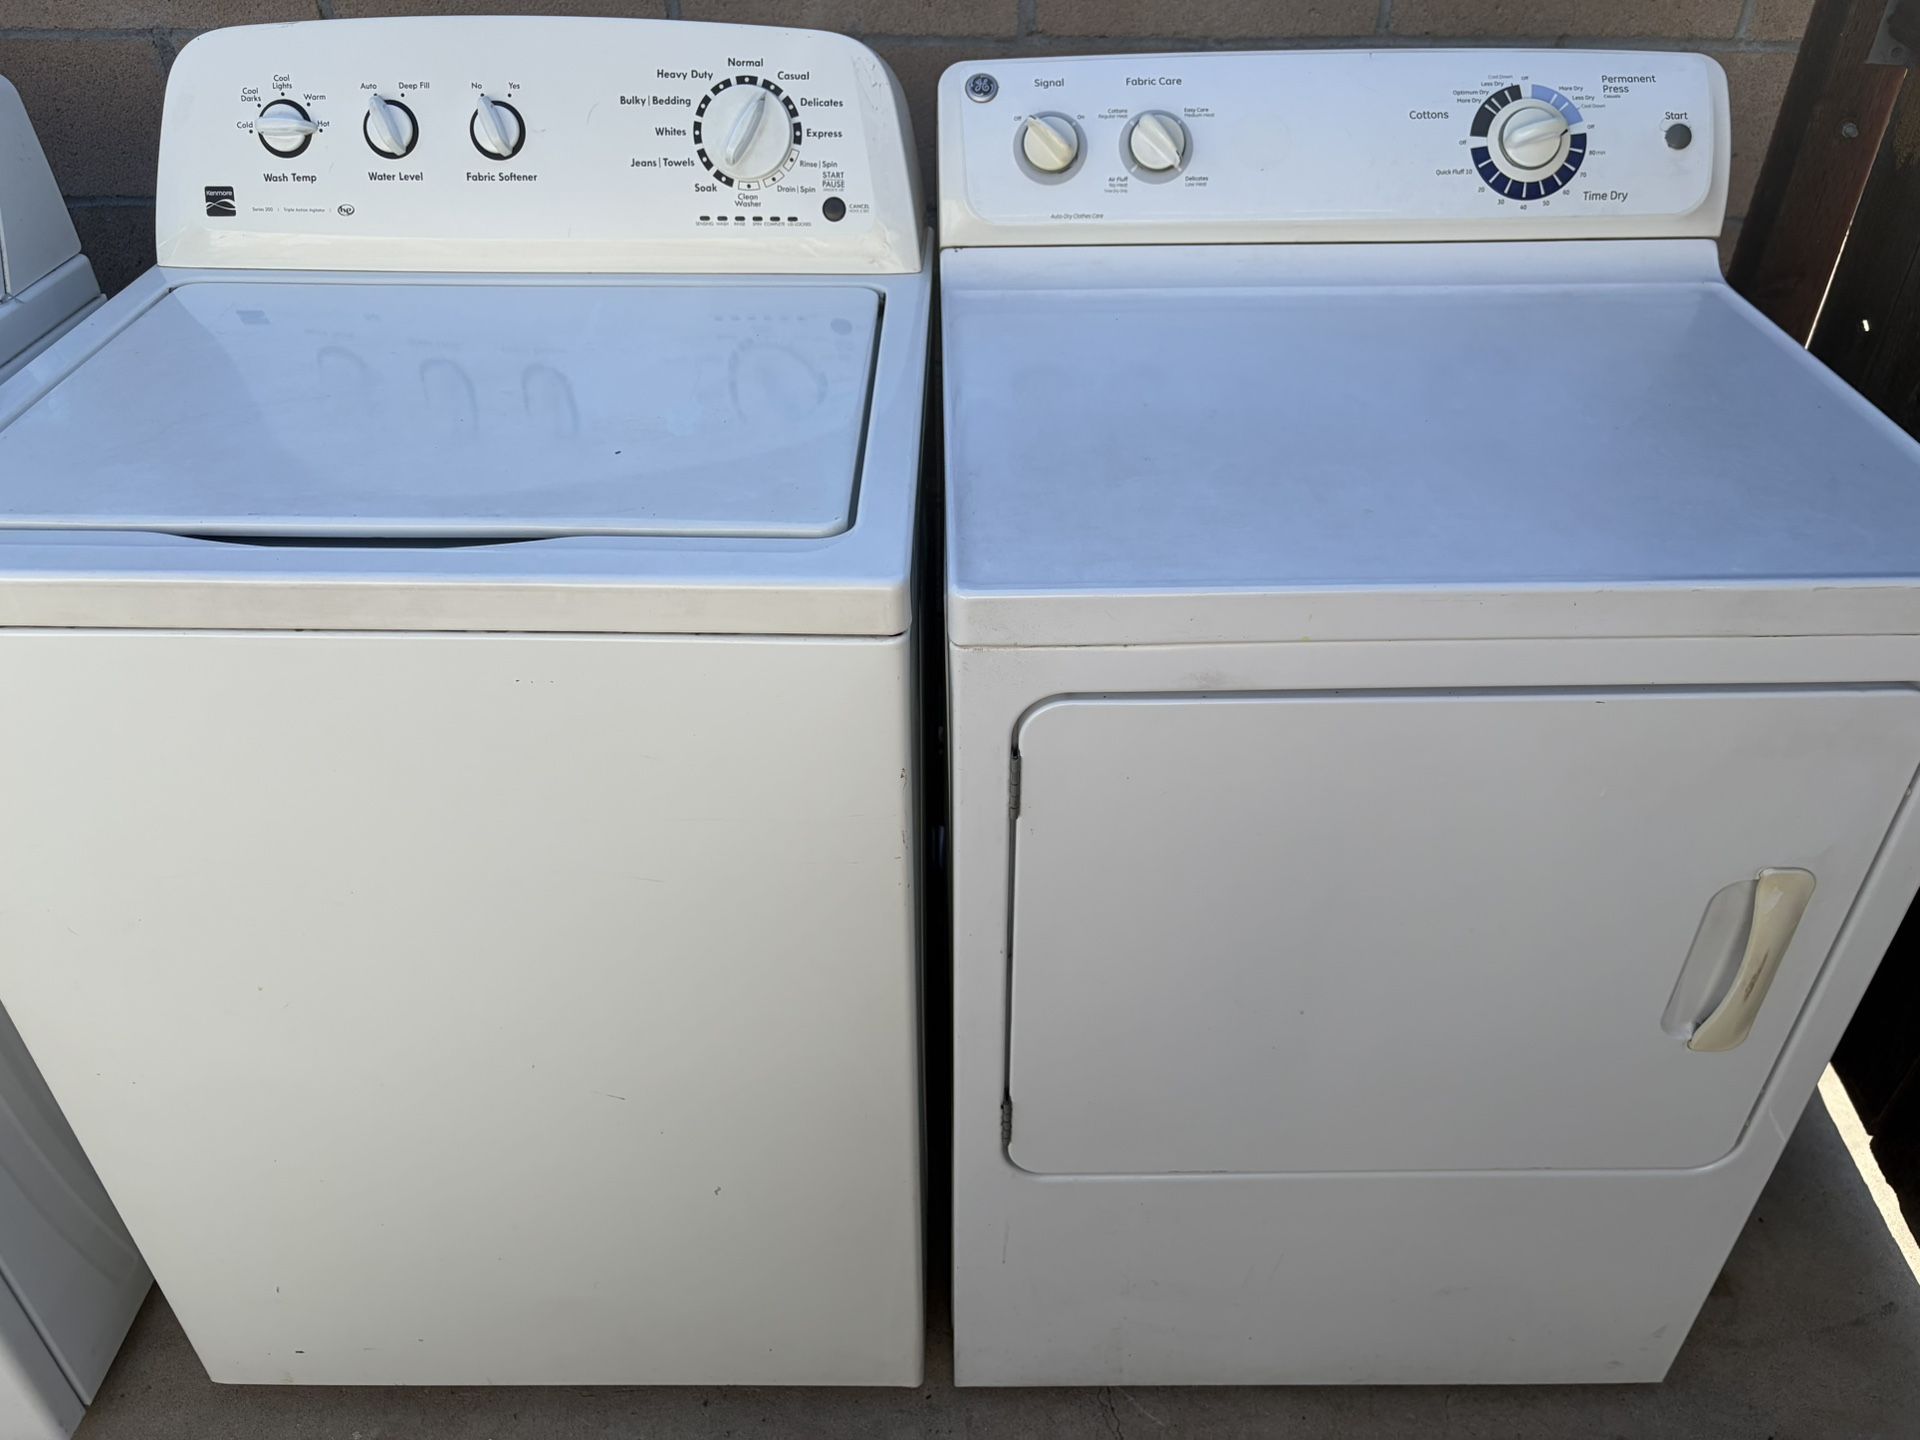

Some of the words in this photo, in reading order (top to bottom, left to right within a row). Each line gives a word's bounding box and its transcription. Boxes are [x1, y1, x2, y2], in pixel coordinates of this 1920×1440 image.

[728, 58, 763, 67] Normal
[274, 74, 290, 82] Cool
[657, 69, 687, 80] Heavy
[691, 70, 713, 80] Duty
[778, 71, 810, 80] Casual
[1602, 75, 1656, 83] Permanent
[272, 82, 292, 90] Lights
[398, 82, 418, 90] Deep
[508, 82, 520, 90] Yes
[1034, 78, 1064, 89] Signal
[1126, 77, 1156, 86] Fabric
[1159, 77, 1182, 86] Care
[1603, 84, 1630, 94] Press
[620, 96, 646, 106] Bulky
[652, 96, 692, 107] Bedding
[800, 98, 844, 108] Delicates
[1409, 110, 1449, 120] Cottons
[1665, 111, 1688, 120] Start
[655, 127, 686, 136] Whites
[806, 128, 842, 139] Express
[630, 158, 657, 167] Jeans
[663, 158, 695, 167] Towels
[822, 161, 838, 169] Spin
[264, 173, 288, 182] Wash
[291, 173, 317, 184] Temp
[368, 172, 396, 181] Water
[400, 172, 424, 181] Level
[466, 172, 495, 181] Fabric
[498, 172, 538, 182] Softener
[694, 183, 717, 192] Soak
[800, 186, 816, 194] Spin
[1583, 191, 1607, 201] Time
[1610, 191, 1628, 202] Dry
